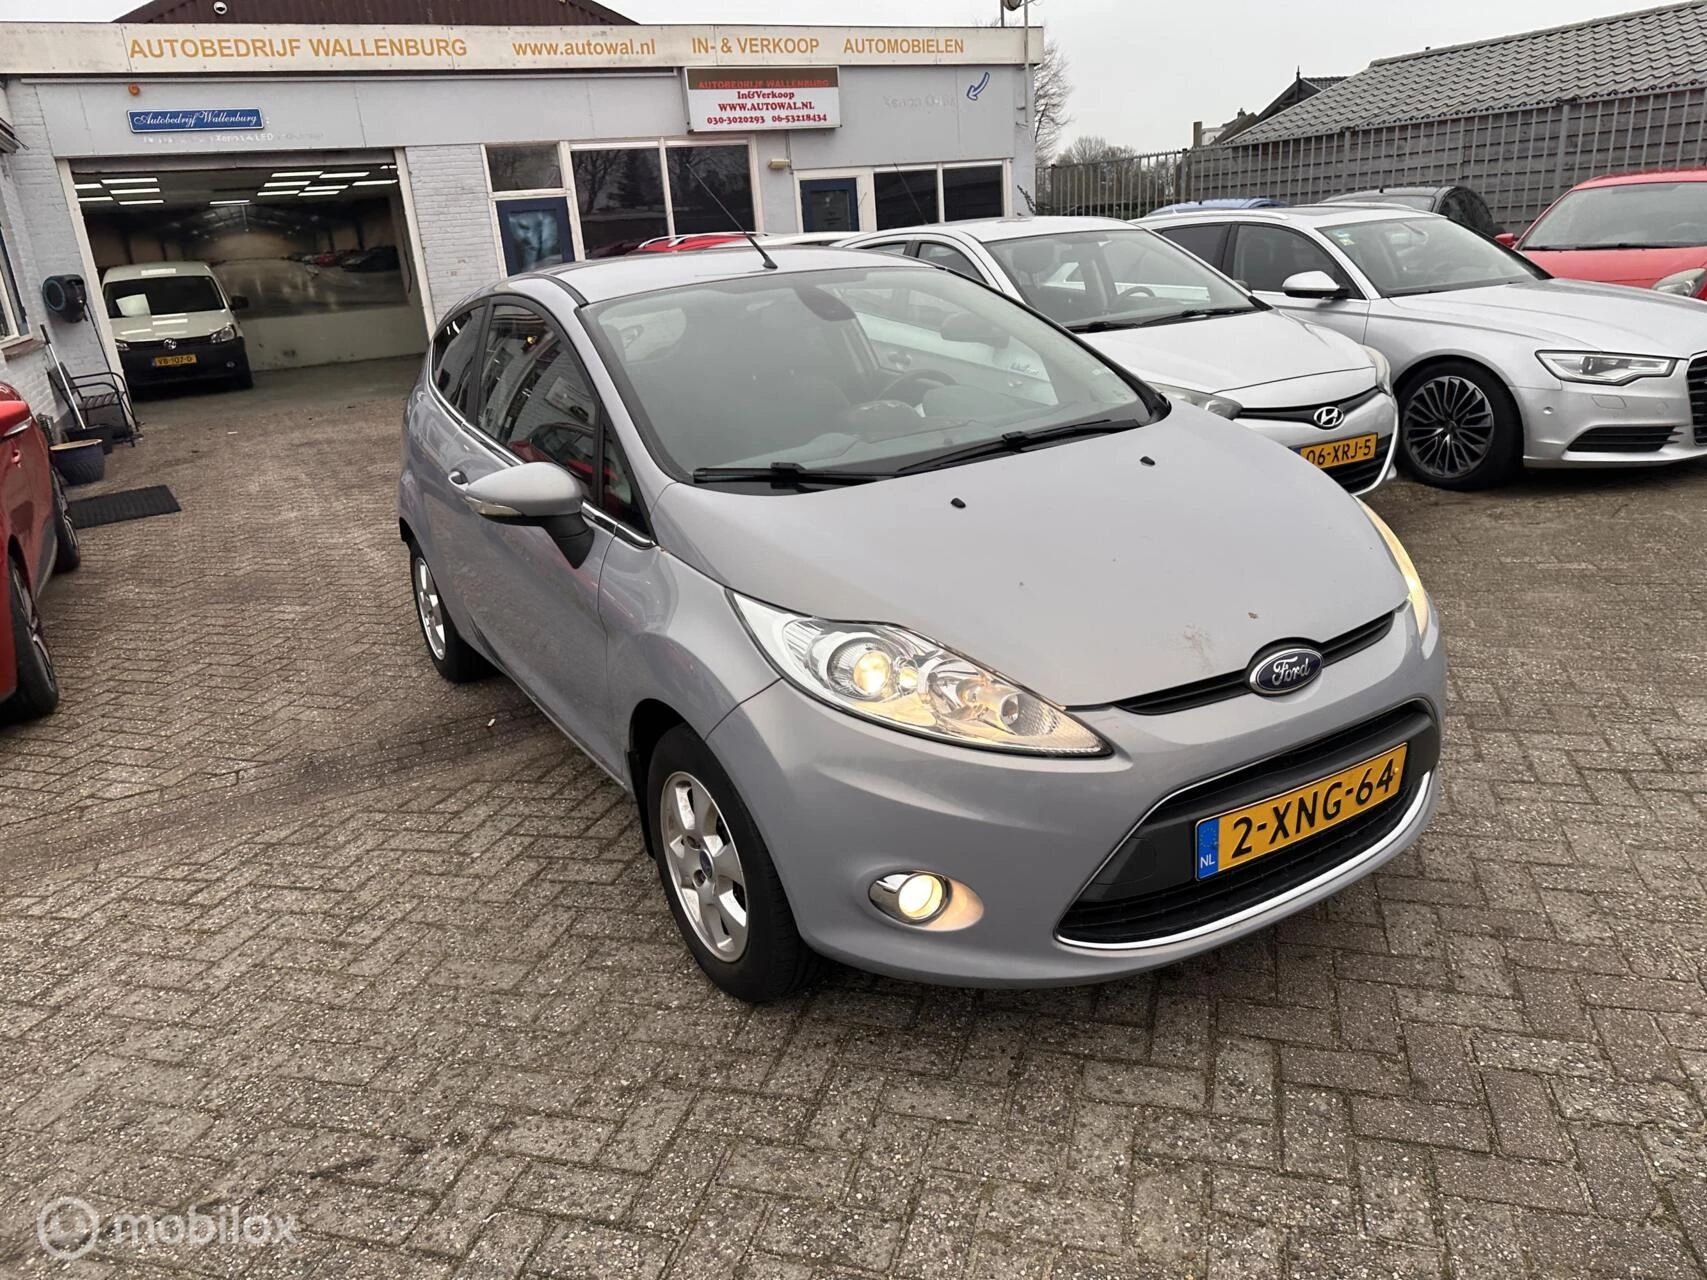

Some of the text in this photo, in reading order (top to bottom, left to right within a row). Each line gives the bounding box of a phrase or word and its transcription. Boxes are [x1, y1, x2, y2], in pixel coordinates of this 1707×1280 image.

[129, 38, 467, 58] AUTOBEDRIJF WALLENBURG
[512, 39, 655, 56] www.autowal.nl
[692, 38, 820, 54] IN- & VERKOOP
[843, 38, 964, 53] AUTOMOBIELEN
[698, 79, 829, 89] AUTOBEDRIJF WALLENBURG
[718, 101, 815, 112] WWW.AUTOWAL.NL
[133, 110, 257, 127] Autobedrijf Wallenburg
[706, 114, 827, 125] 030-3020293 06-53218434
[1306, 438, 1372, 466] 06-XRJ-5
[1271, 656, 1310, 686] Ford
[1231, 758, 1395, 859] 2-XNG-64
[1200, 856, 1216, 869] NL
